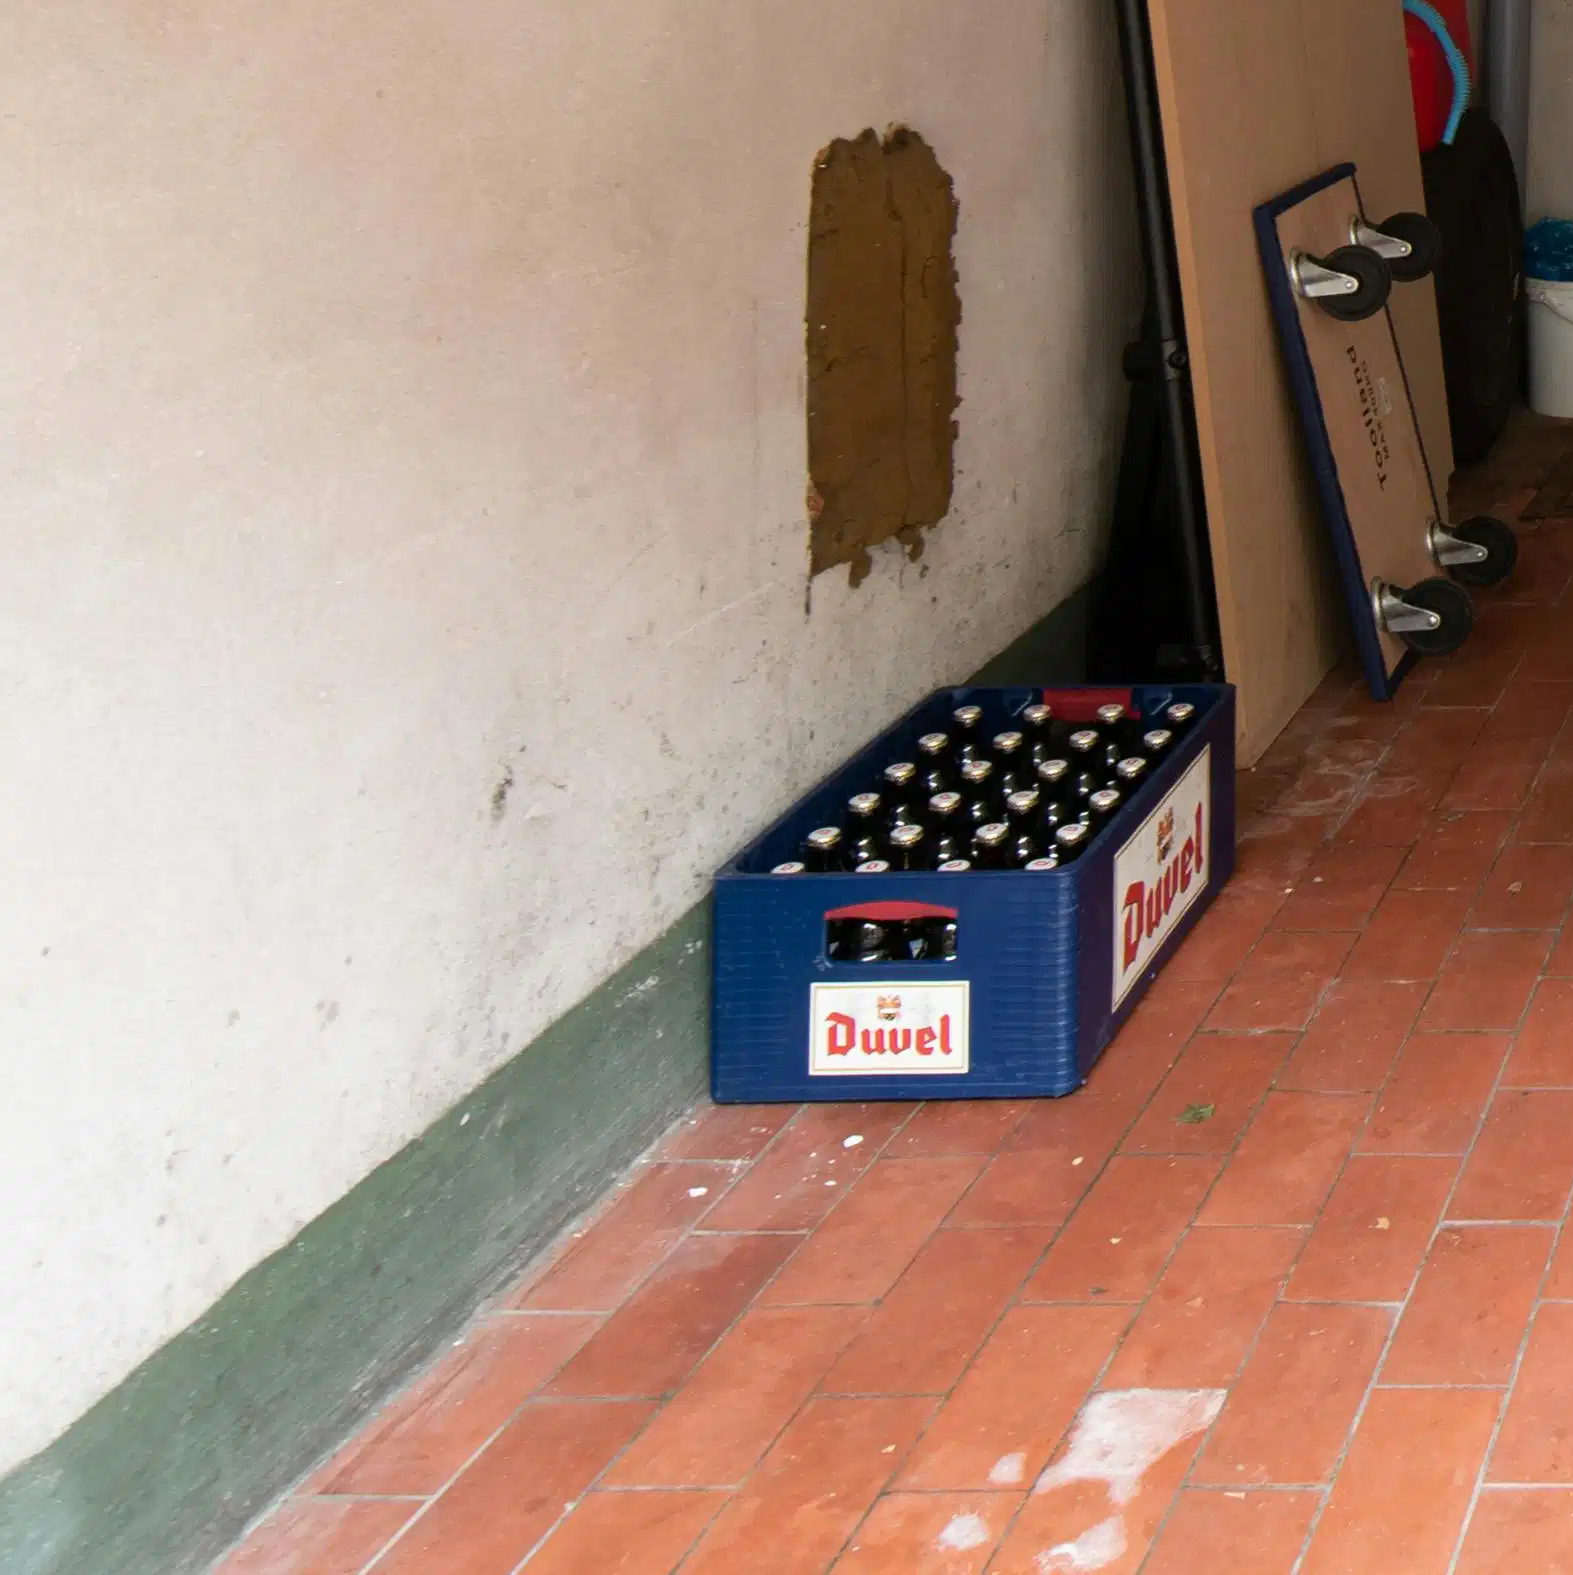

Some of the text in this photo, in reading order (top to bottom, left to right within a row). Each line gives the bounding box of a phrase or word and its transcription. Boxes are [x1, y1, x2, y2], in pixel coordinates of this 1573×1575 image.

[1345, 345, 1388, 493] Toolland
[1121, 801, 1206, 972] Duvel
[825, 1011, 953, 1057] Duvel
